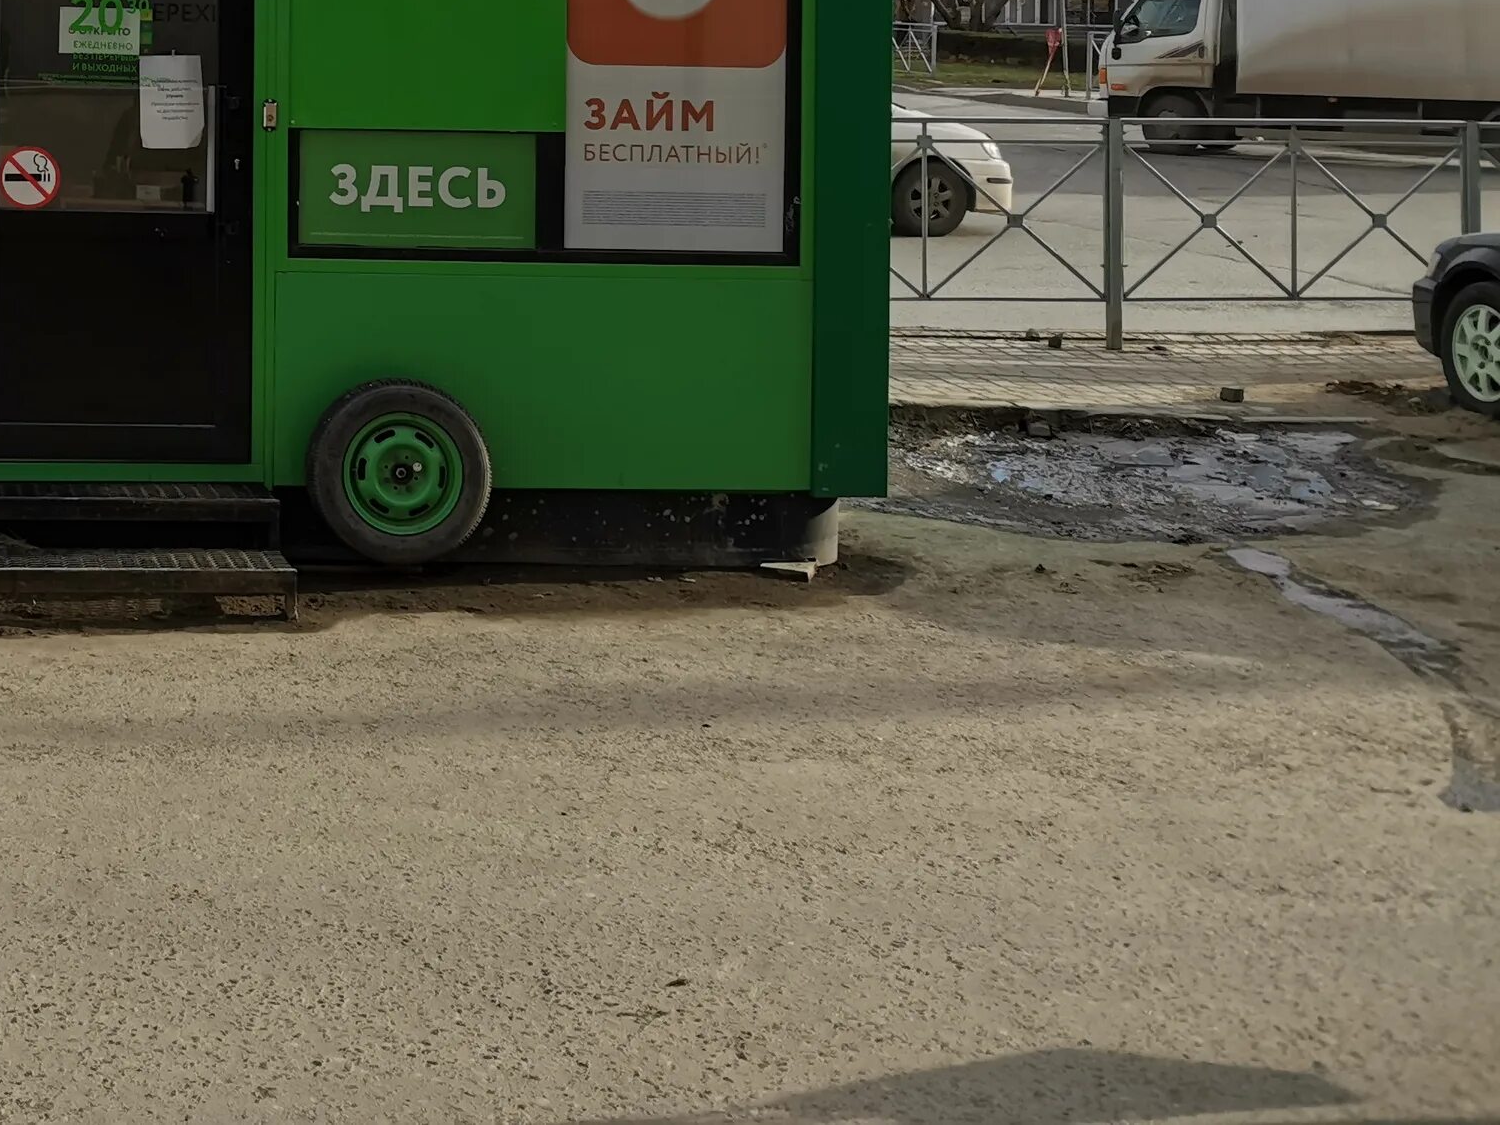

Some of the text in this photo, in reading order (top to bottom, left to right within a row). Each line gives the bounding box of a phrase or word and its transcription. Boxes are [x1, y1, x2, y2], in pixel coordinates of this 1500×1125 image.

[73, 40, 134, 51] ЕЖЕДНЕВНО
[81, 63, 137, 73] ВЫХОДНЫХ
[583, 91, 714, 132] ЗАЙМ
[328, 163, 506, 213] ЗДЕСЬ
